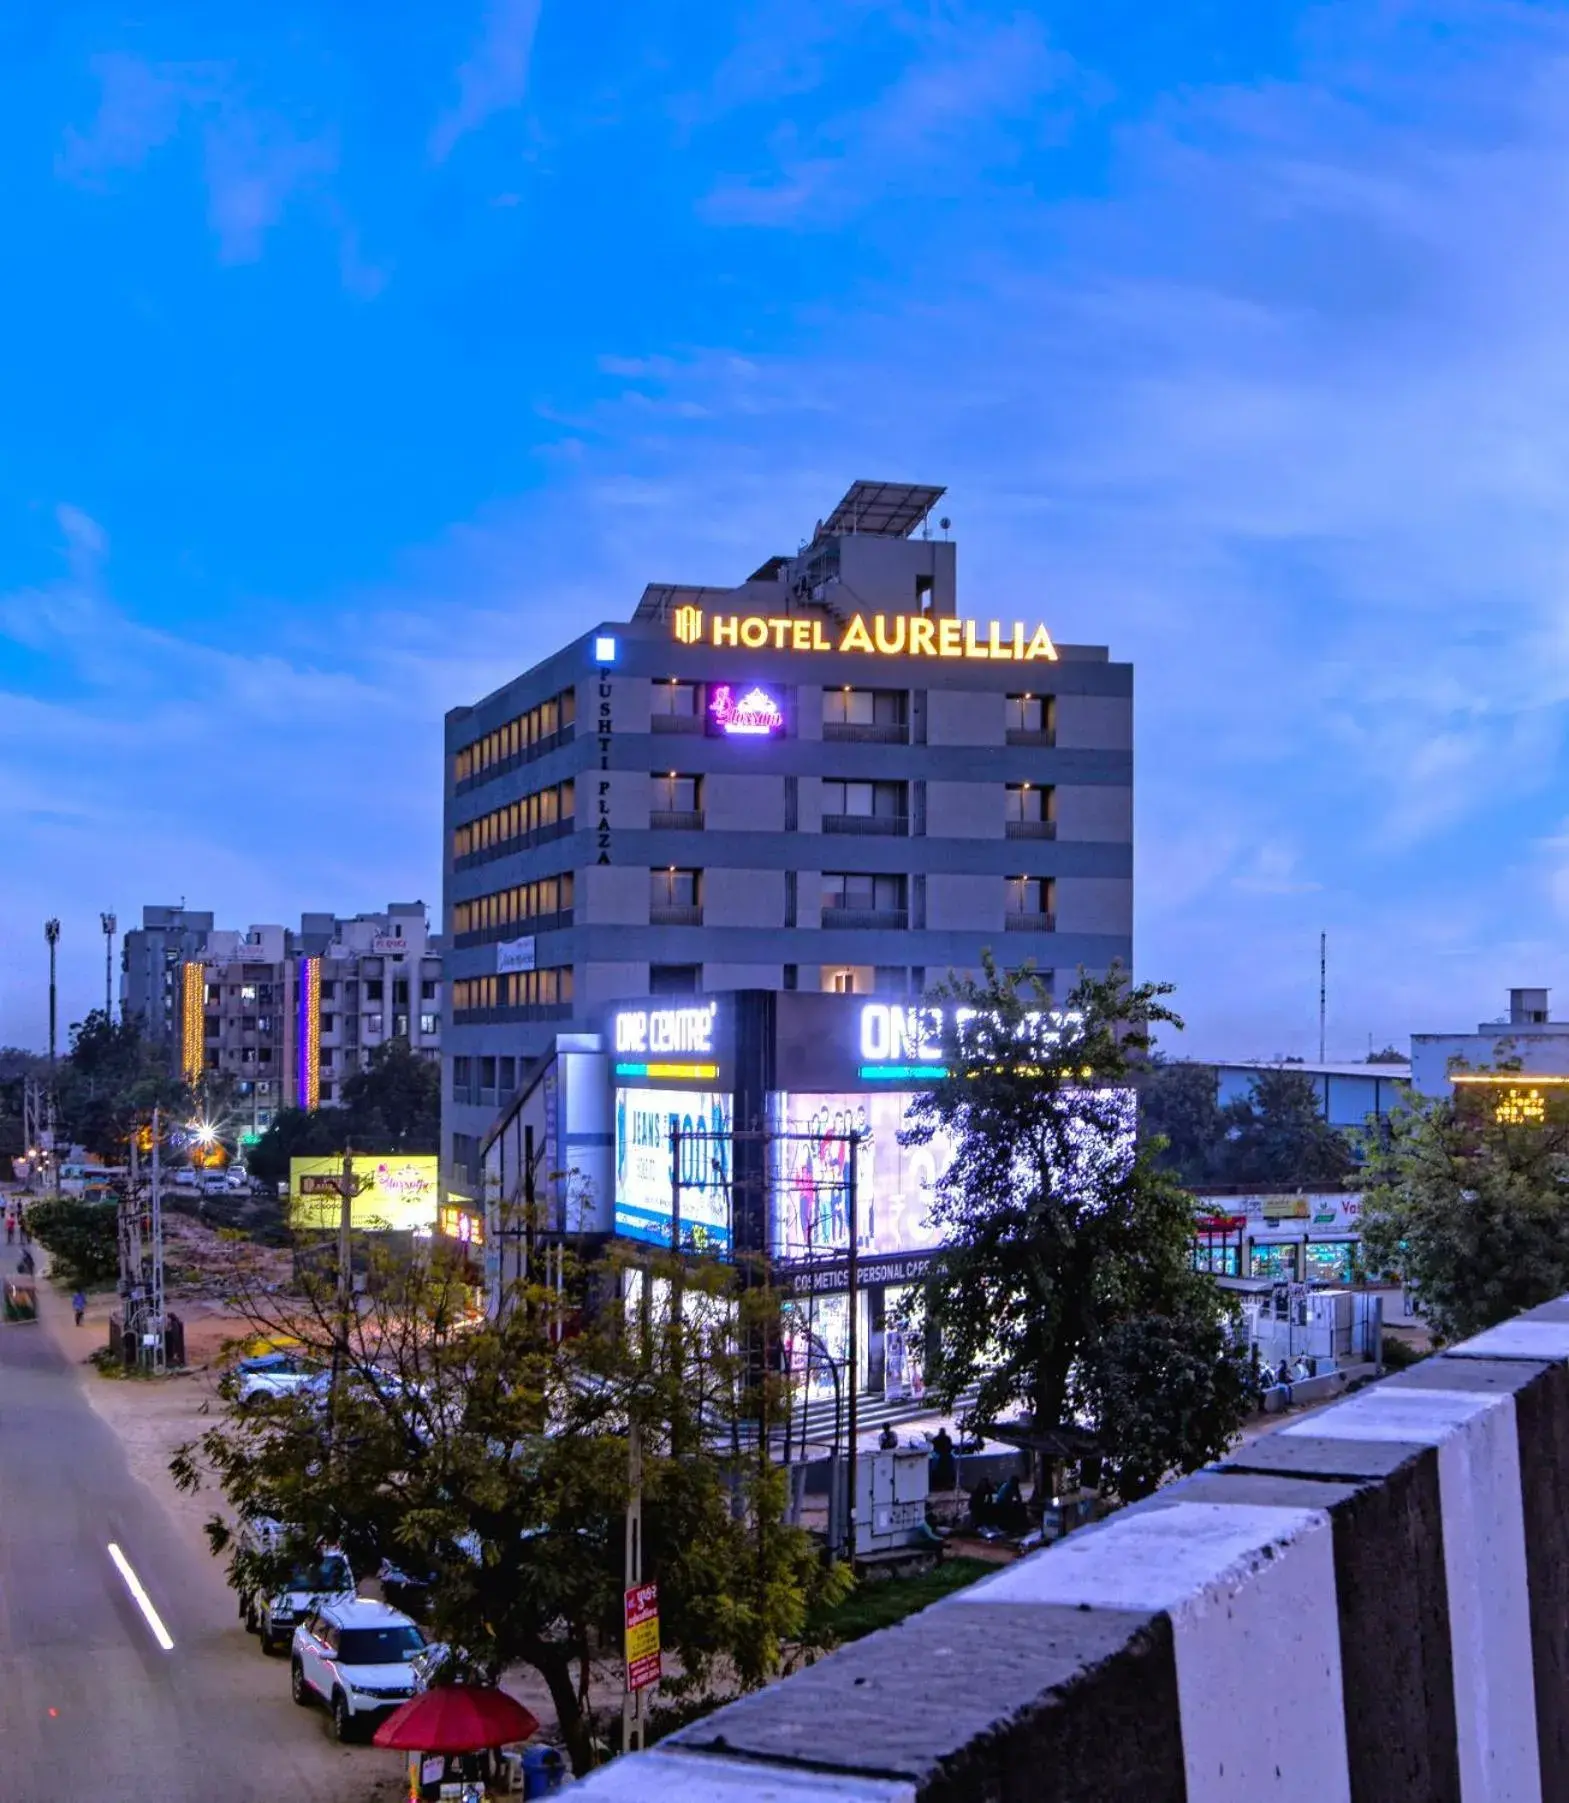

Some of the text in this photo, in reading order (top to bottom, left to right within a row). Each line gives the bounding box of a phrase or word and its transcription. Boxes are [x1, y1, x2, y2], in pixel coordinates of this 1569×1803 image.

[713, 613, 1058, 661] HOTEL AURELLIA
[597, 667, 613, 865] PUSHTI PLAZA
[632, 1110, 660, 1148] JEANS
[856, 1263, 906, 1284] PERSONAL
